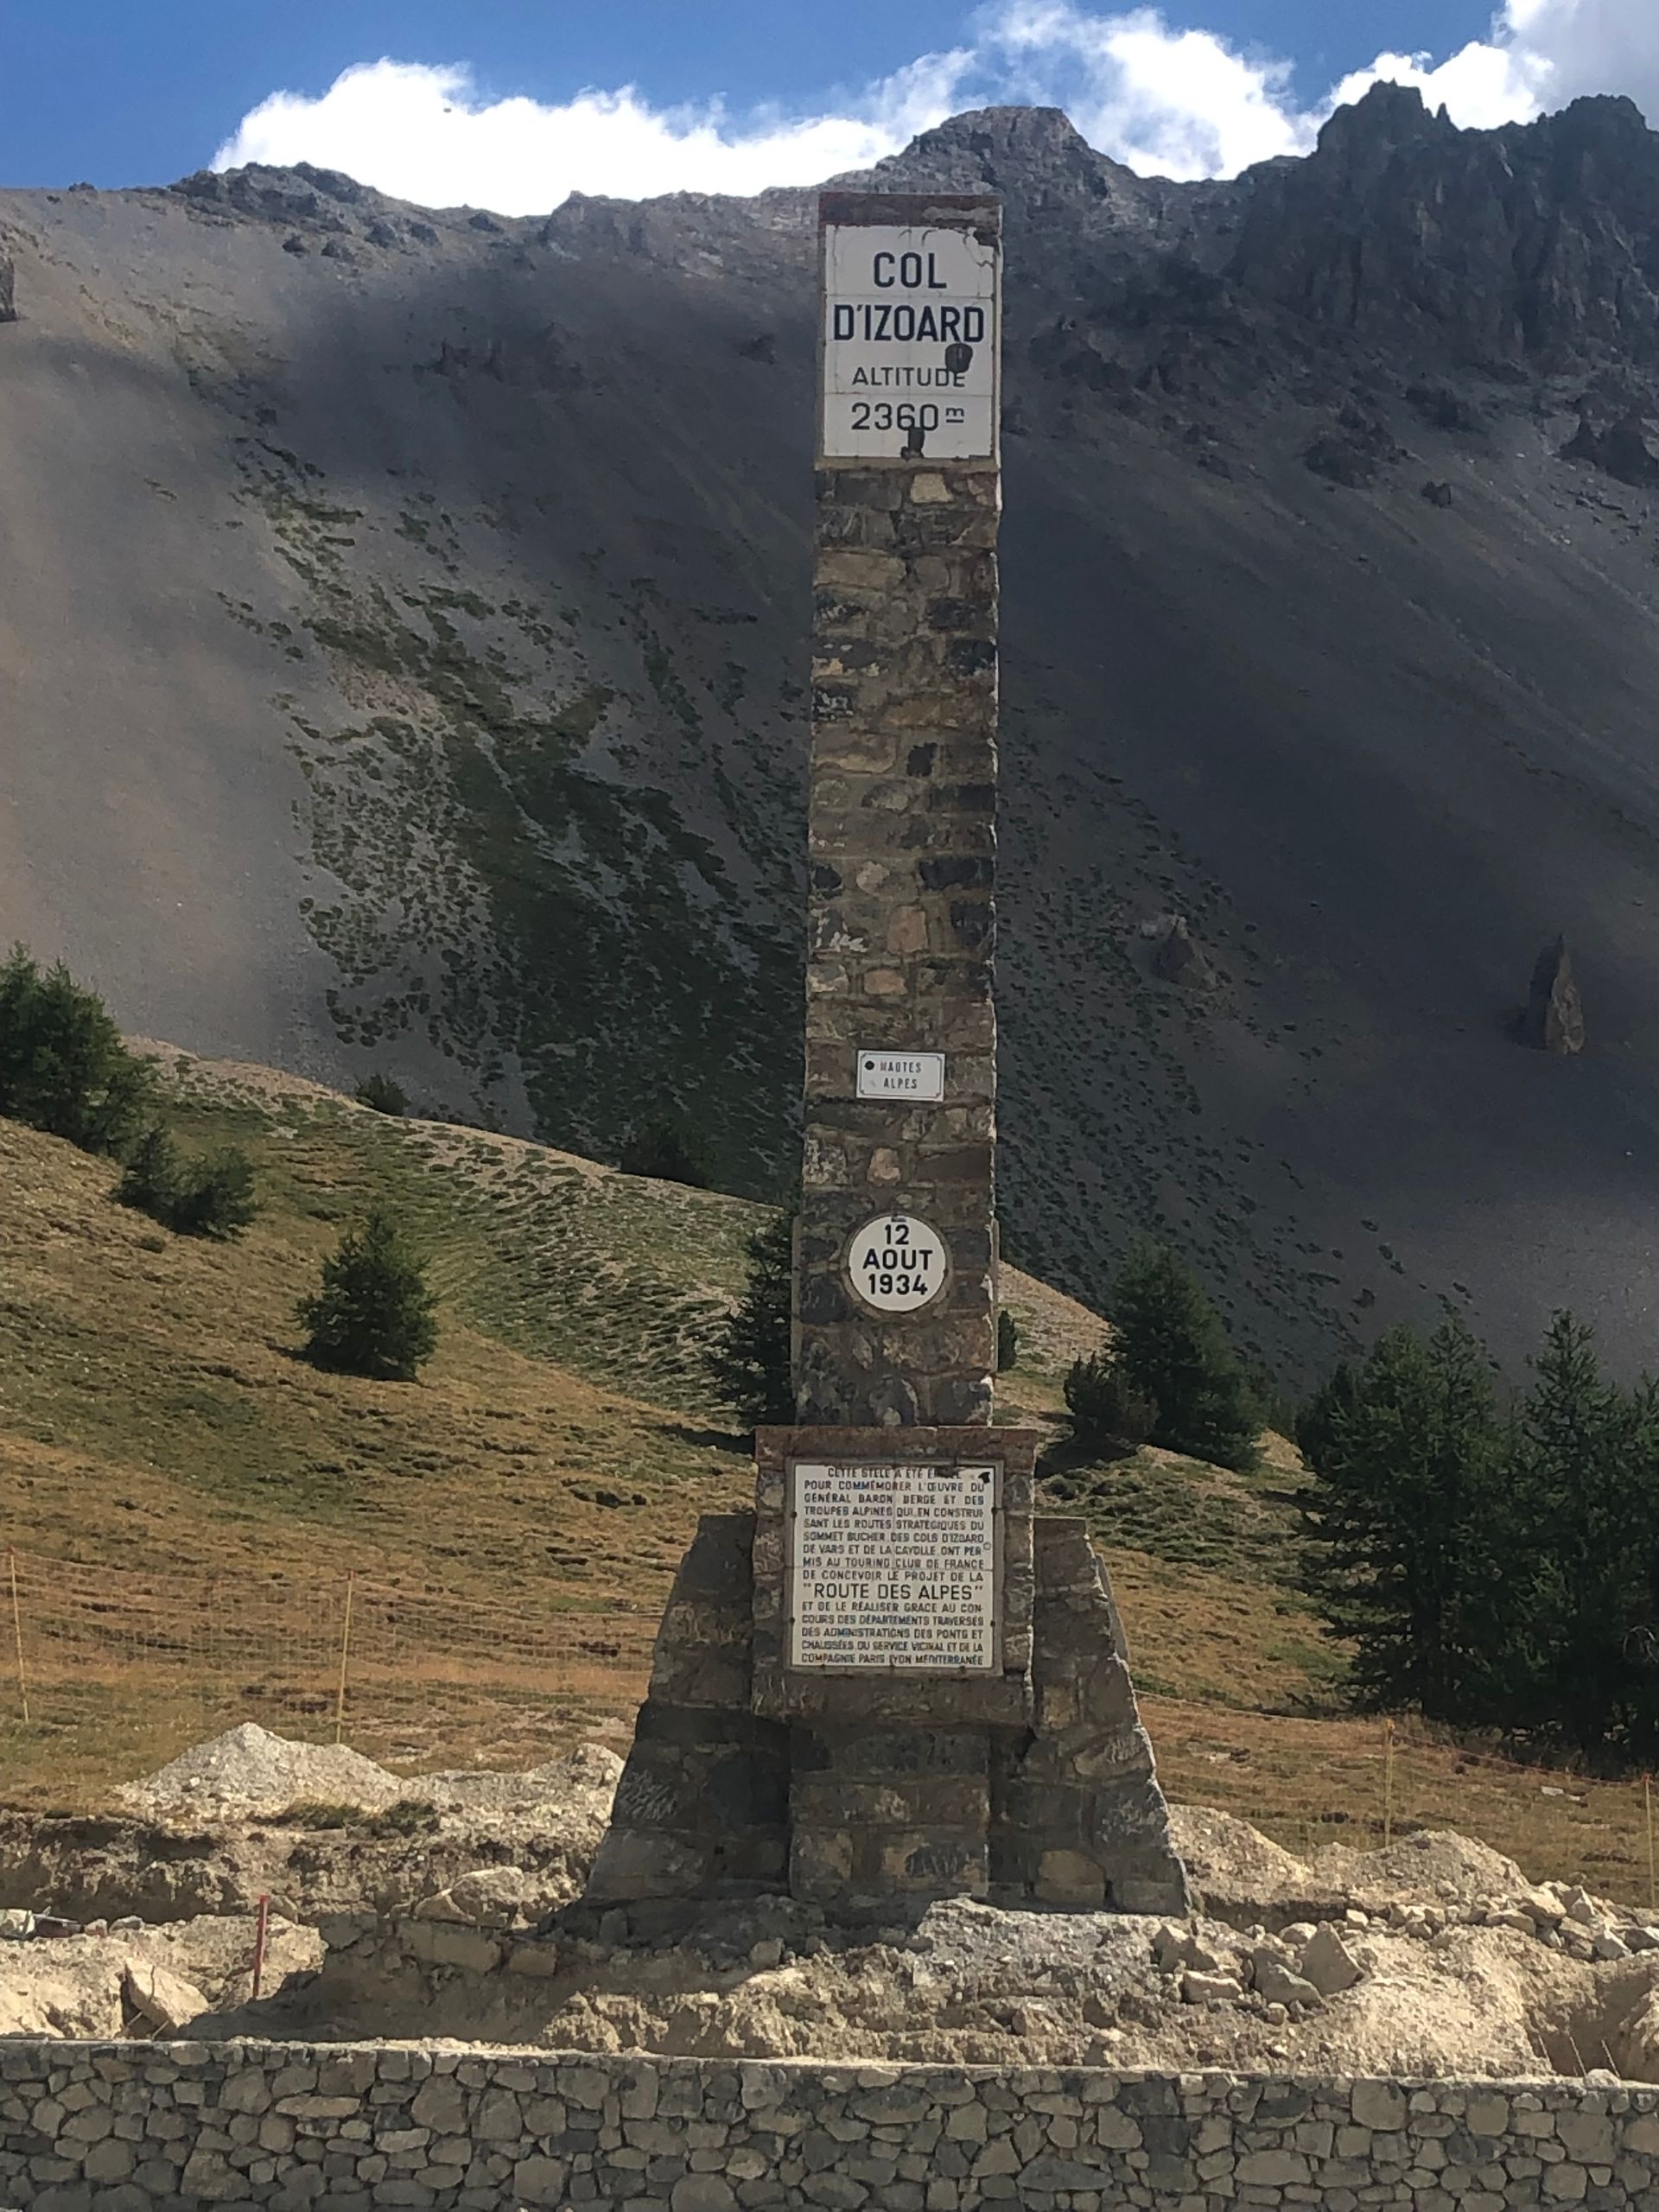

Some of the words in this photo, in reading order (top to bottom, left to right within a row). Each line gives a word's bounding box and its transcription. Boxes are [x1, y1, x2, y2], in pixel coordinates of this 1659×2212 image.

[874, 251, 947, 289] COL
[834, 304, 984, 342] D'IZOARD
[852, 366, 966, 387] ALTITUDE
[851, 402, 939, 431] 2360
[880, 1061, 922, 1073] HAUTES
[883, 1077, 918, 1089] ALPES
[885, 1224, 910, 1245] 12
[862, 1249, 933, 1270] AOUT
[868, 1273, 928, 1295] 1934
[828, 1468, 857, 1478] CETTE
[894, 1469, 901, 1478] A
[804, 1480, 831, 1490] POUR
[971, 1483, 984, 1492] DU
[858, 1493, 893, 1503] BARON
[944, 1495, 957, 1504] ET
[964, 1496, 984, 1505] DES
[804, 1506, 849, 1516] TROUPES
[852, 1506, 893, 1516] ALPINES
[918, 1508, 930, 1517] EN
[804, 1518, 829, 1528] SANT
[833, 1519, 850, 1529] LES
[855, 1519, 892, 1529] ROUTES
[970, 1521, 984, 1530] DU
[804, 1531, 843, 1541] SOMMET
[891, 1533, 910, 1542] DES
[913, 1533, 938, 1542] COLS
[803, 1544, 816, 1554] DE
[819, 1544, 845, 1554] VARS
[849, 1545, 860, 1554] ET
[864, 1545, 875, 1554] DE
[880, 1545, 892, 1554] LA
[895, 1546, 935, 1555] CAYOLLE
[941, 1546, 961, 1555] ONT
[803, 1557, 822, 1567] MIS
[827, 1558, 840, 1567] AU
[845, 1558, 890, 1568] TOURING
[895, 1558, 921, 1568] CLUB
[926, 1559, 939, 1569] DE
[944, 1559, 984, 1569] FRANCE
[803, 1570, 816, 1580] DE
[822, 1570, 882, 1580] CONCEVOIR
[888, 1571, 899, 1580] LE
[905, 1571, 945, 1581] PROJET
[950, 1573, 964, 1582] DE
[969, 1573, 984, 1582] LA
[878, 1584, 912, 1599] DES
[802, 1601, 813, 1611] ET
[817, 1602, 830, 1611] DE
[836, 1602, 847, 1611] LE
[942, 1603, 957, 1613] AU
[802, 1614, 835, 1624] COURS
[837, 1615, 856, 1624] DES
[802, 1627, 820, 1637] DES
[823, 1628, 911, 1638] ADMINISTRATIONS
[914, 1629, 933, 1639] DES
[937, 1629, 969, 1639] PONTS
[972, 1630, 983, 1639] ET
[857, 1641, 870, 1650] DU
[873, 1641, 908, 1651] SERVICE
[947, 1643, 957, 1652] ET
[959, 1643, 969, 1652] DE
[974, 1643, 983, 1652] LA
[802, 1653, 855, 1663] COMPAGNIE
[859, 1654, 885, 1663] PARIS
[889, 1654, 912, 1664] LYON
